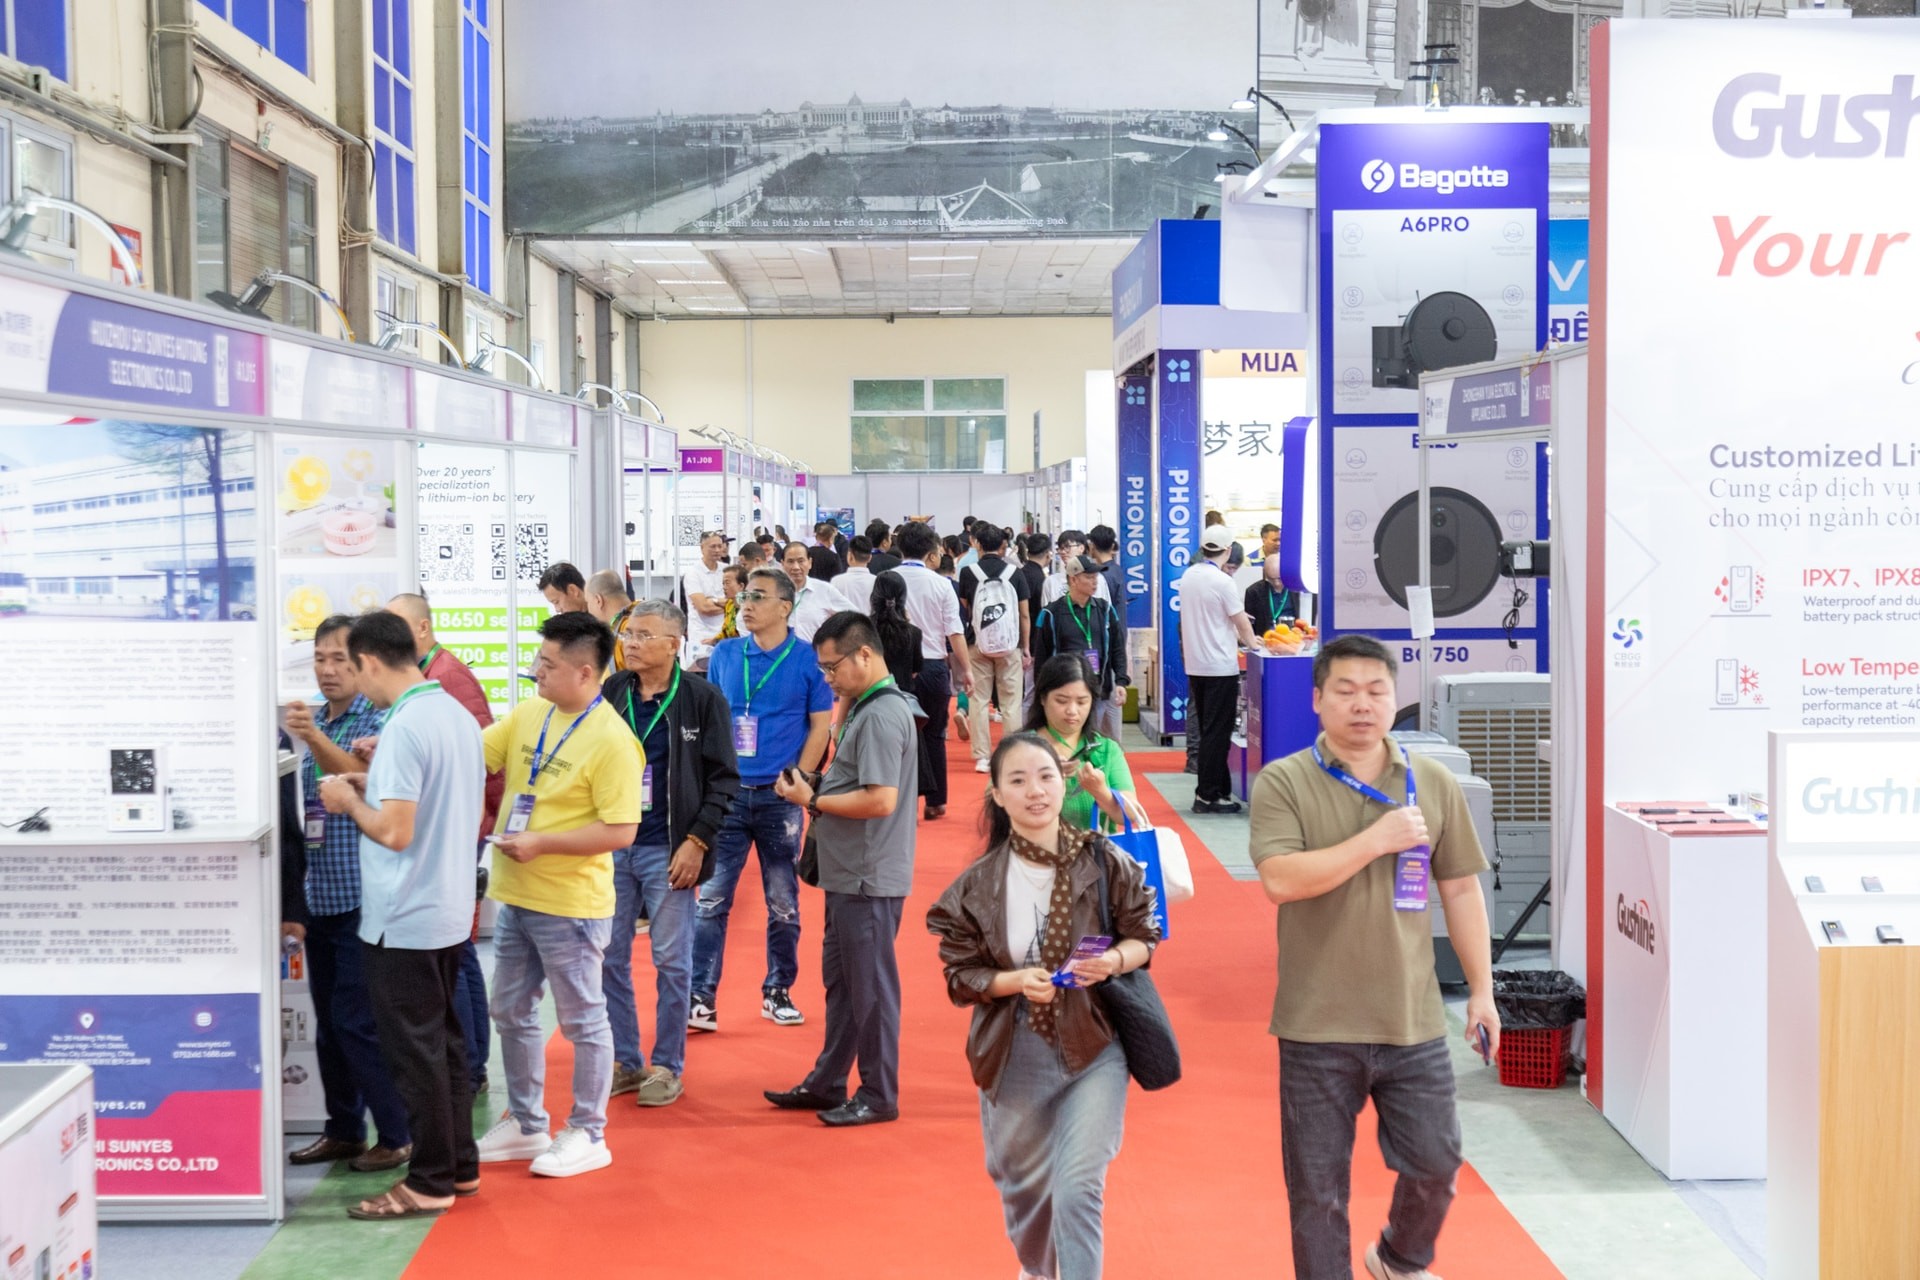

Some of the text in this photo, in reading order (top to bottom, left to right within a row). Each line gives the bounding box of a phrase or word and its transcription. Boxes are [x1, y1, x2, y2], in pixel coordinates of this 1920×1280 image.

[1400, 216, 1470, 232] A6PRO
[1712, 215, 1911, 278] Your
[1241, 352, 1298, 373] MUA
[1204, 420, 1287, 457] 梦家
[1709, 442, 1920, 469] Customized Li
[444, 467, 458, 477] 20
[417, 480, 490, 491] pecialization
[1709, 472, 1911, 503] Cung cấp dịch vụ
[1168, 469, 1191, 567] PHONG
[1709, 507, 1750, 528] cho
[1757, 507, 1801, 531] mọi
[1809, 507, 1880, 532] ngành
[1127, 476, 1149, 595] PHONG VŨ
[1804, 595, 1876, 611] Waterproof
[1879, 594, 1903, 607] and
[432, 611, 485, 628] 18650
[1803, 610, 1851, 624] battery
[1853, 610, 1884, 624] pack
[1802, 658, 1846, 677] Low
[1802, 685, 1913, 698] Low-temperature
[1802, 700, 1883, 713] performance
[1885, 700, 1899, 710] at
[1802, 714, 1916, 728] capacity retention
[1617, 892, 1656, 955] Gushine
[109, 1140, 173, 1153] SUNYES
